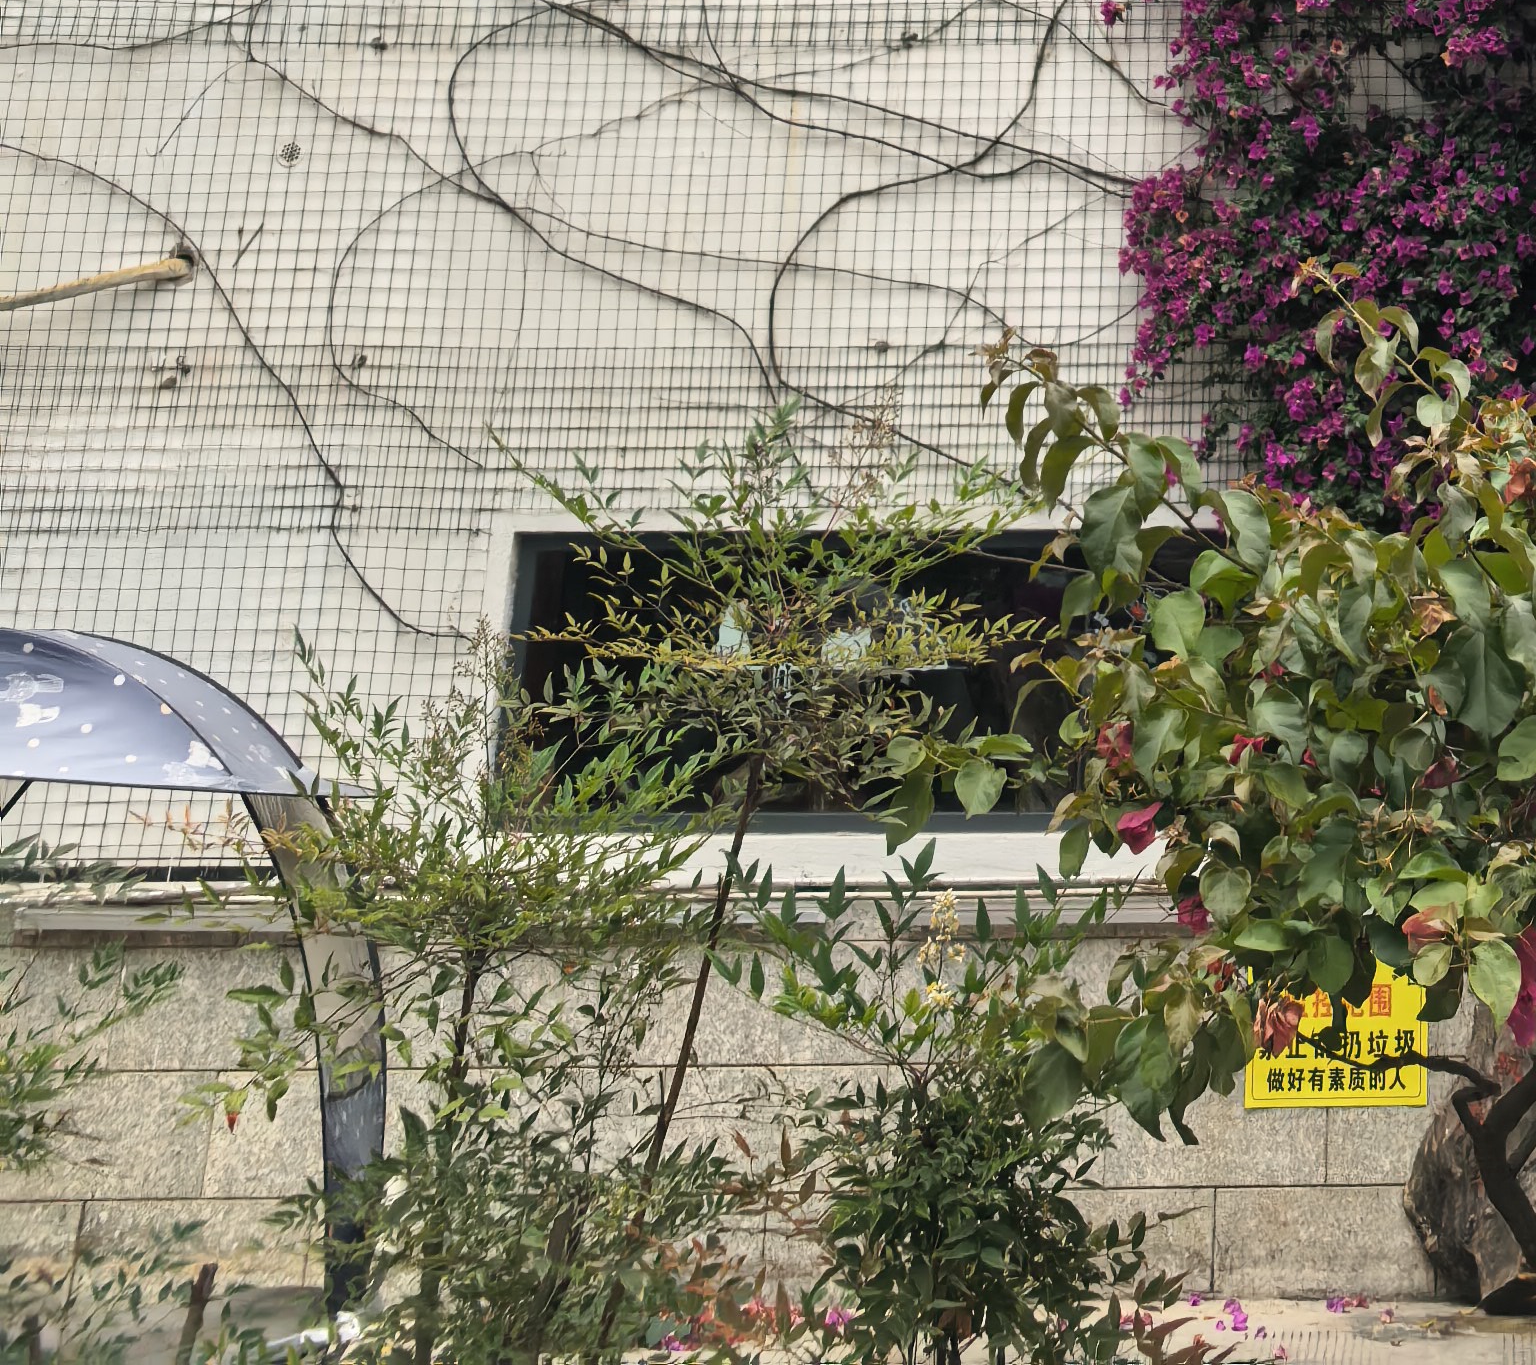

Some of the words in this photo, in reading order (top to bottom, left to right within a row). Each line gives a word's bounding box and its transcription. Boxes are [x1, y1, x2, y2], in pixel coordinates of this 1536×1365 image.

[1266, 1066, 1407, 1093] 做好有素质的人
